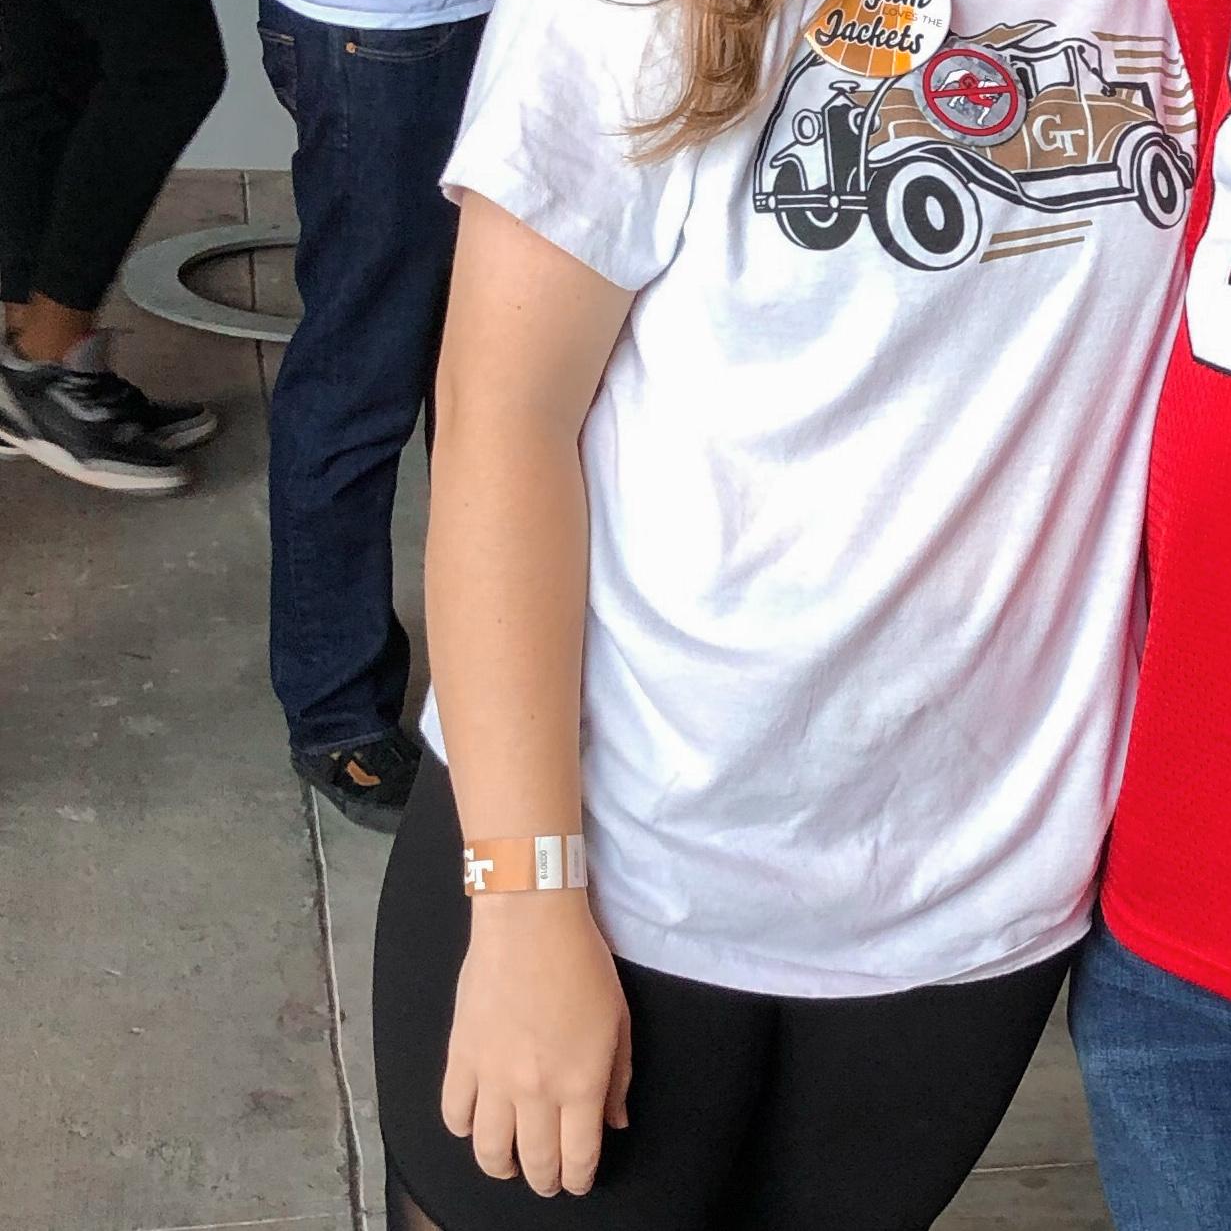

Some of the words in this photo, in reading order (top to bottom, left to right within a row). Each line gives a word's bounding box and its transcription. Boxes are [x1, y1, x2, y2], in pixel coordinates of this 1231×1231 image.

[815, 9, 924, 54] Jackets
[883, 8, 918, 21] LOVES
[922, 15, 943, 28] THE
[1032, 114, 1085, 157] GT
